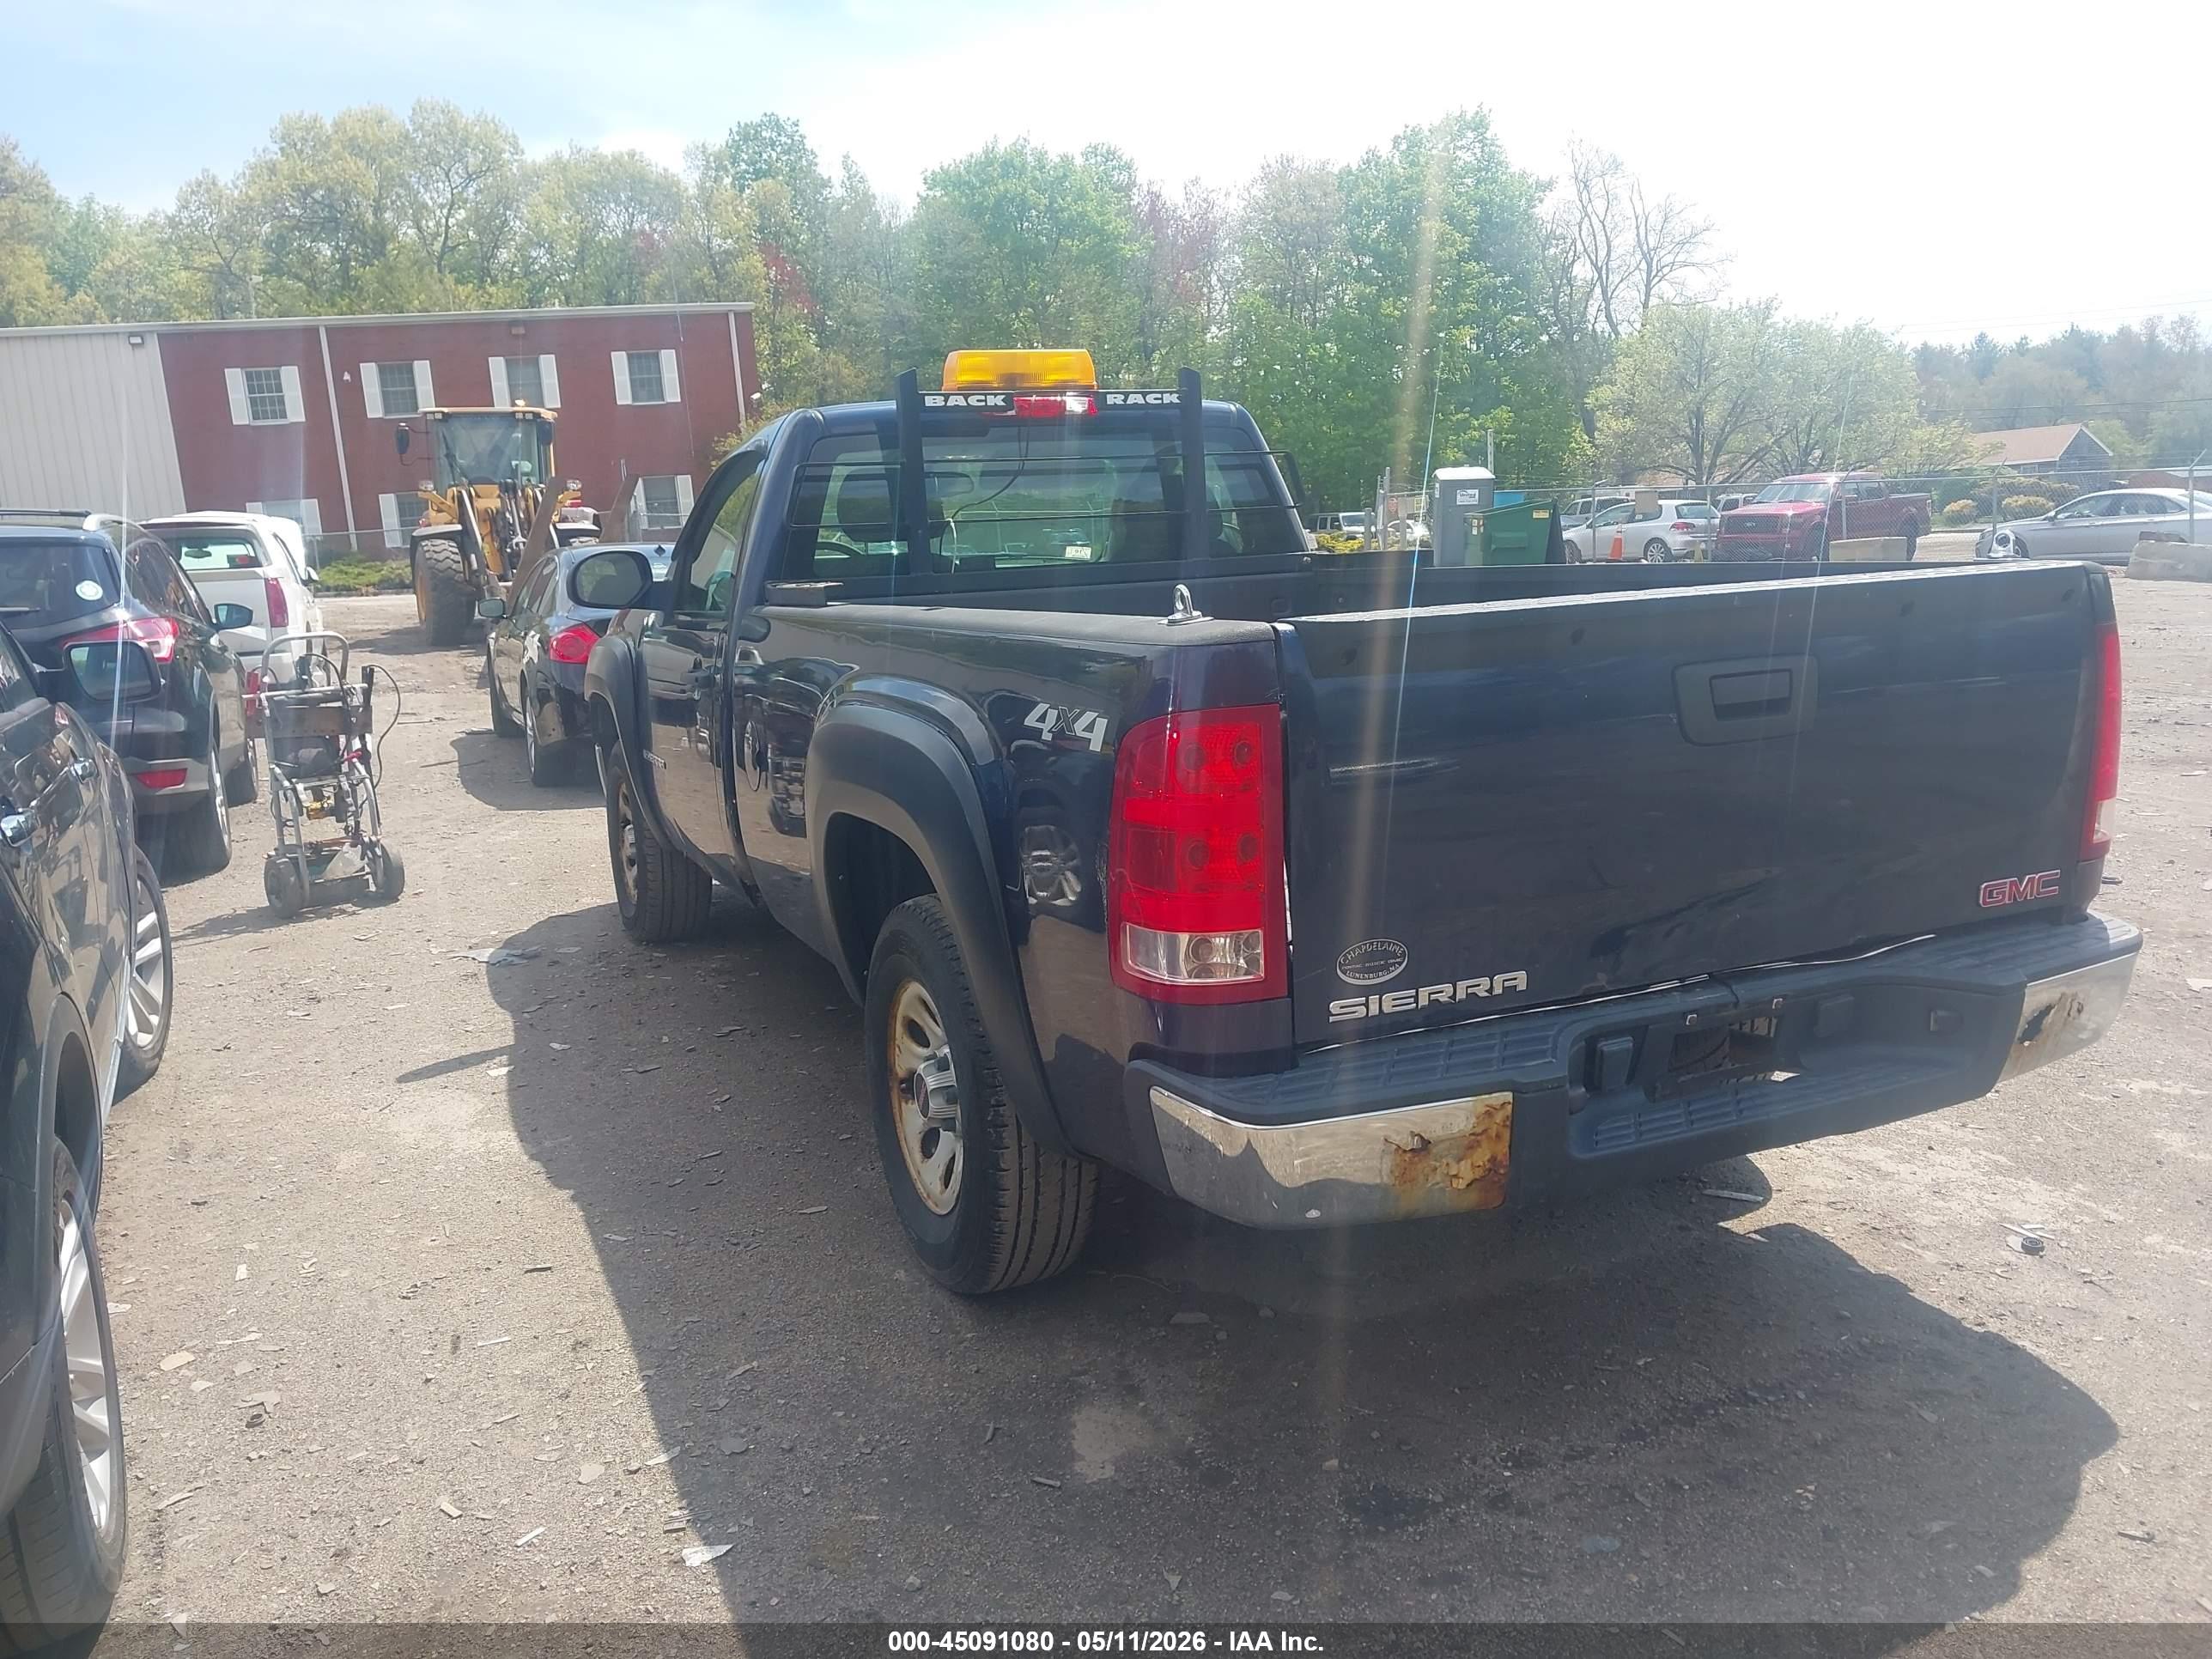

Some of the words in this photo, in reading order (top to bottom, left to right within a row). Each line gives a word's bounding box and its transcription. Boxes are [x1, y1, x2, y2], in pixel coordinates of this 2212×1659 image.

[924, 394, 1006, 407] BACK
[1106, 392, 1182, 405] RACK
[1979, 869, 2061, 908] GMC
[1340, 941, 1404, 964] CHAPDELAINE
[1329, 971, 1527, 1023] SIERRA
